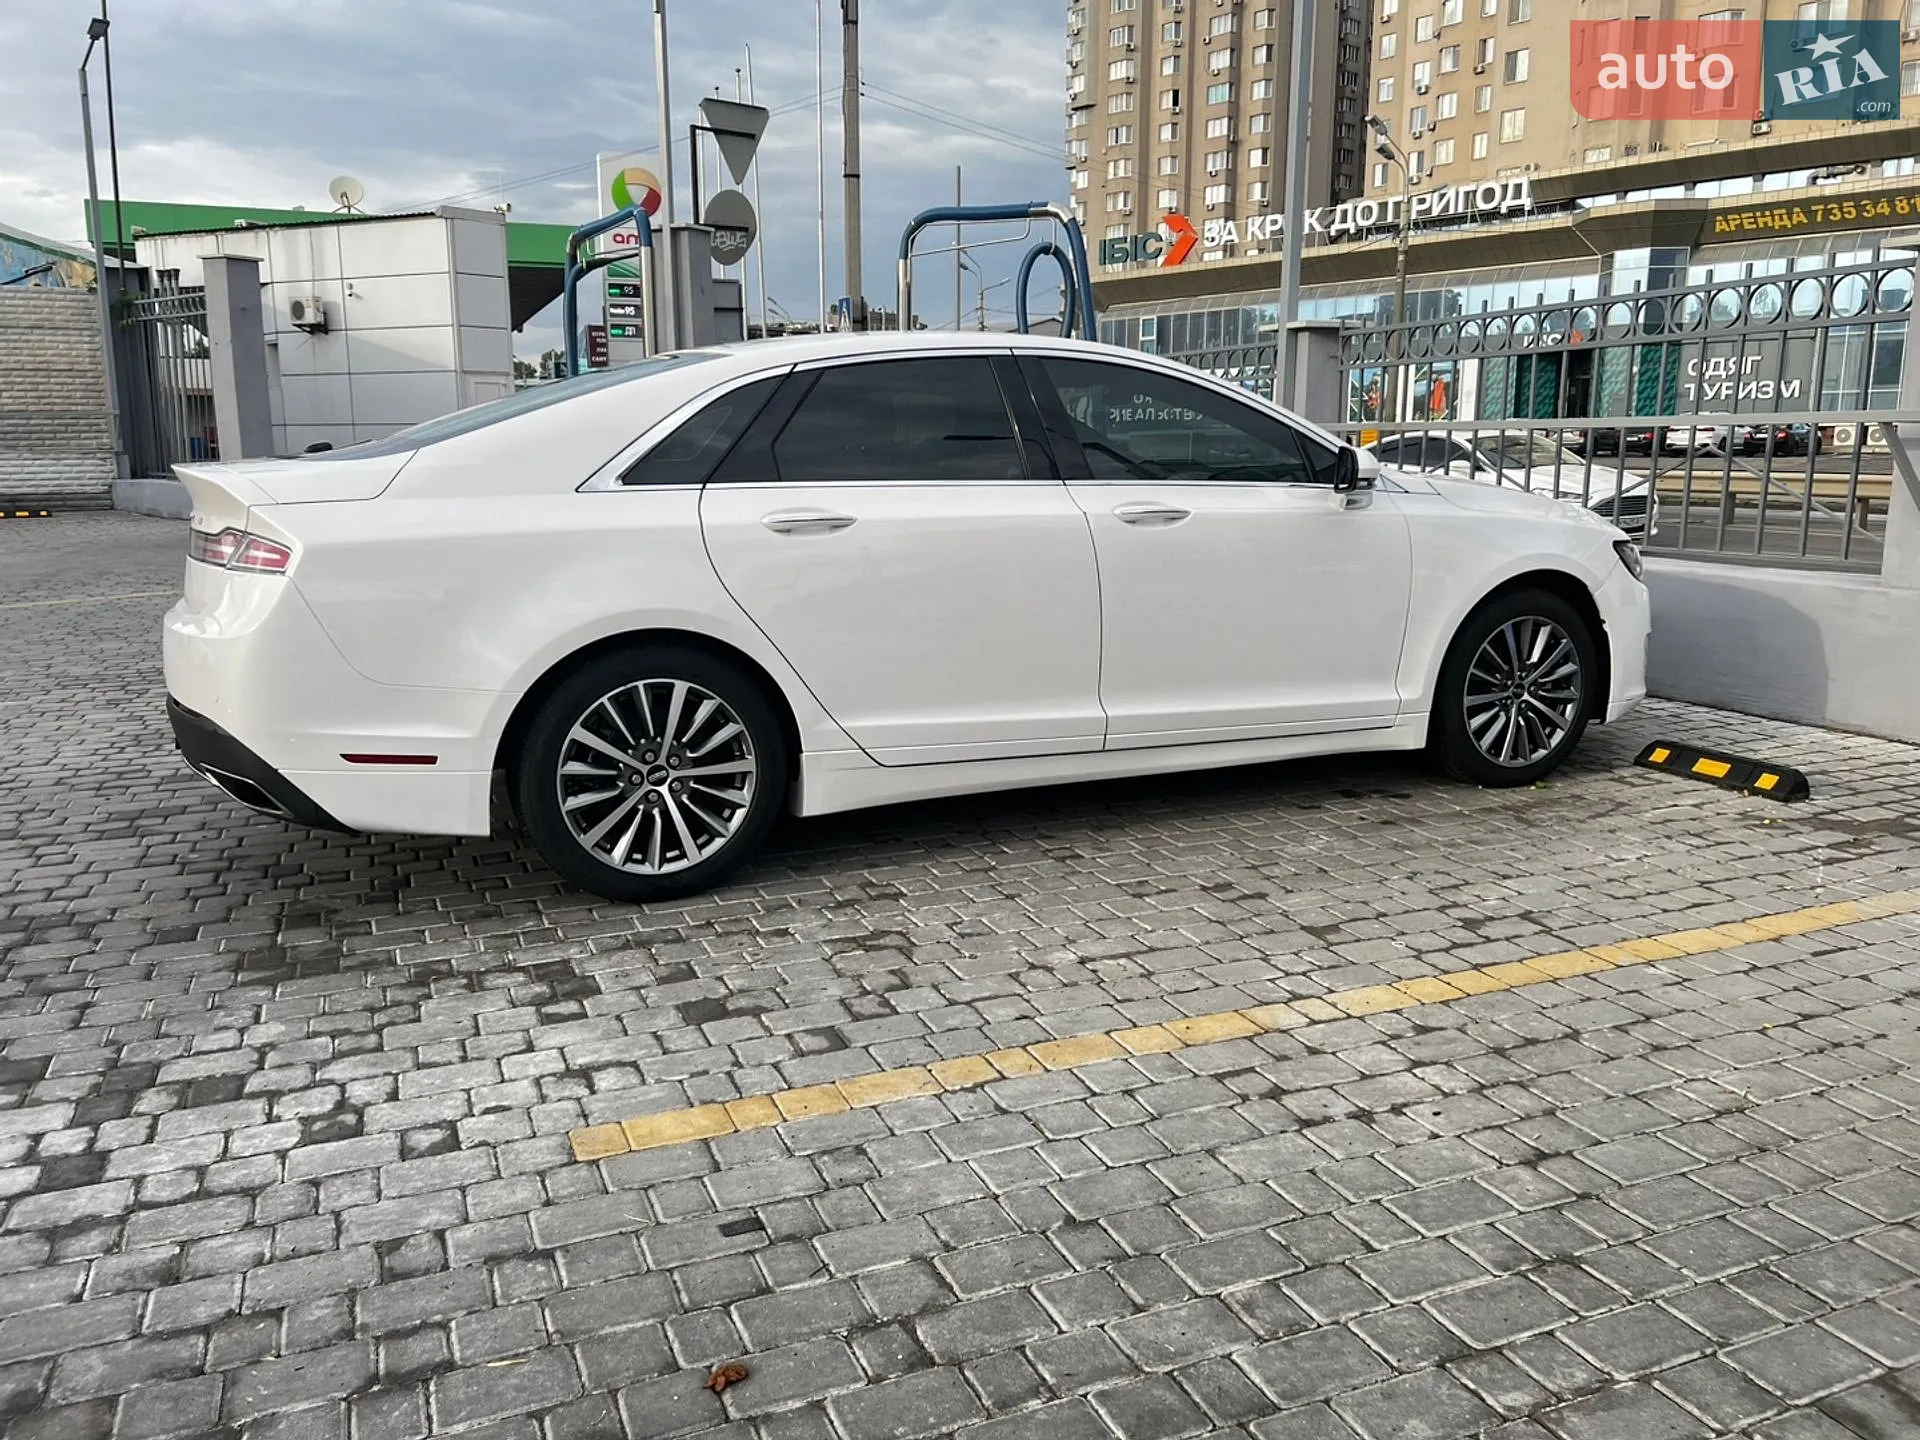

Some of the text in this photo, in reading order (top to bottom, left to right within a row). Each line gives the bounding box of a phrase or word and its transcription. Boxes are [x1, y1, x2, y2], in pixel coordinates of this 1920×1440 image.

[1204, 220, 1239, 248] ЗА
[1247, 206, 1324, 241] КРК
[1330, 200, 1378, 236] ДО
[1714, 207, 1809, 233] АРЕНДА
[1811, 201, 1858, 224] 735
[1861, 197, 1891, 219] 34
[1687, 356, 1763, 379] ОДЯГ
[1684, 379, 1802, 401] ТУРИЗМ
